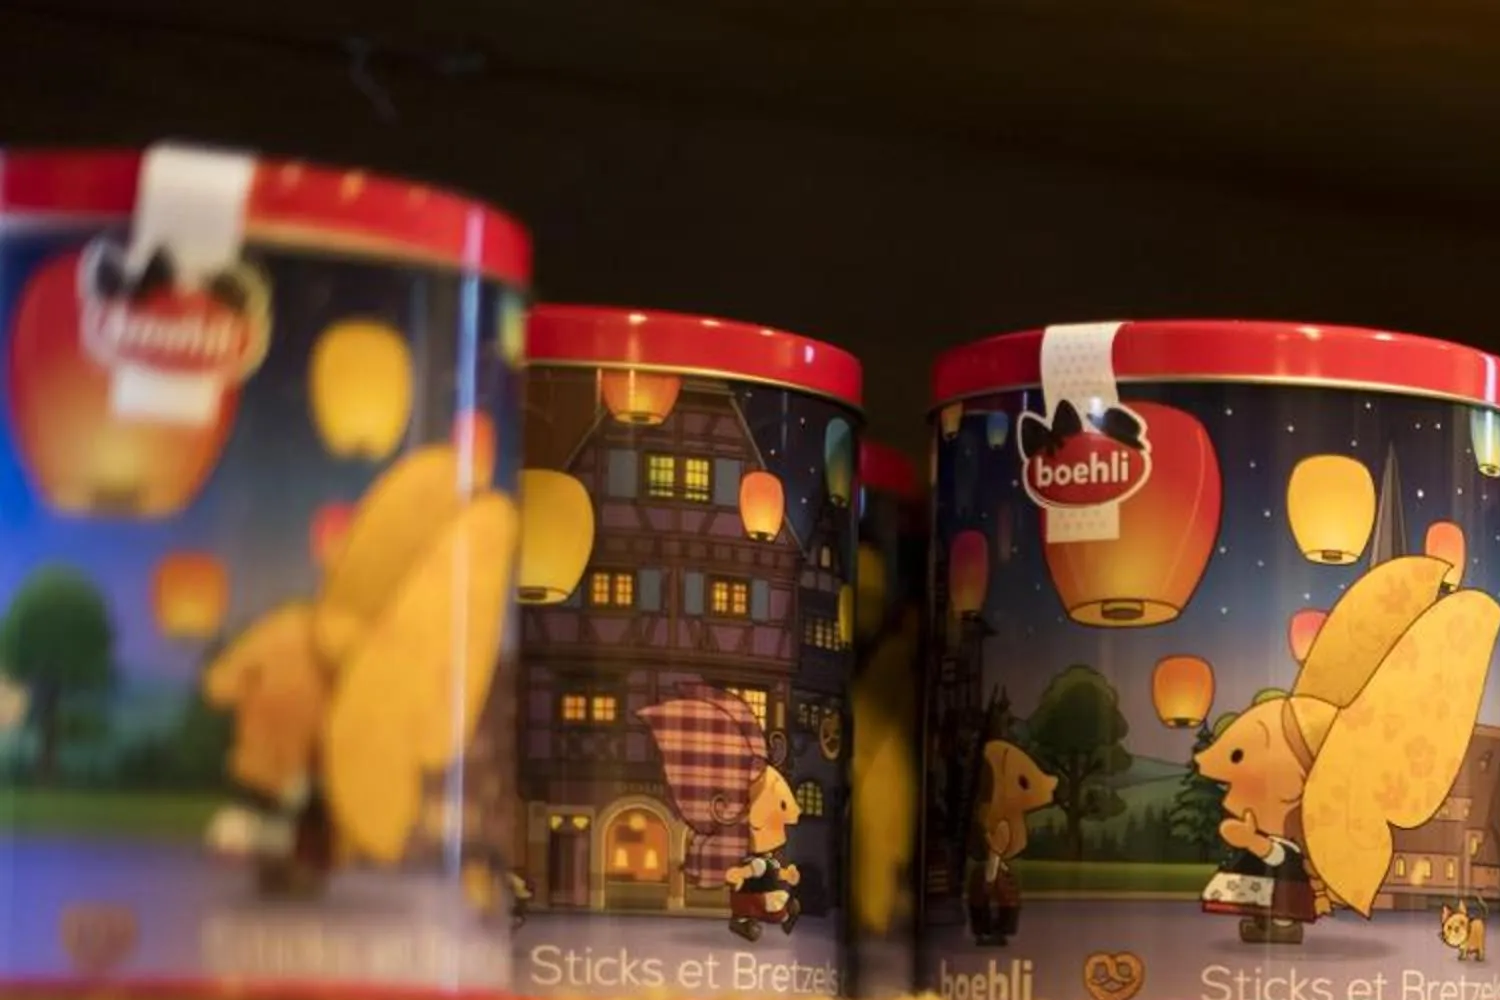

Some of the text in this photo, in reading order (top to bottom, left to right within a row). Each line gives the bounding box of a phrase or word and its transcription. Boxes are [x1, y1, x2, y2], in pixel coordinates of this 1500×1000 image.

[1035, 452, 1130, 488] boehli
[531, 945, 664, 988] Sticks
[678, 953, 720, 990] et
[733, 952, 838, 996] Bretzels
